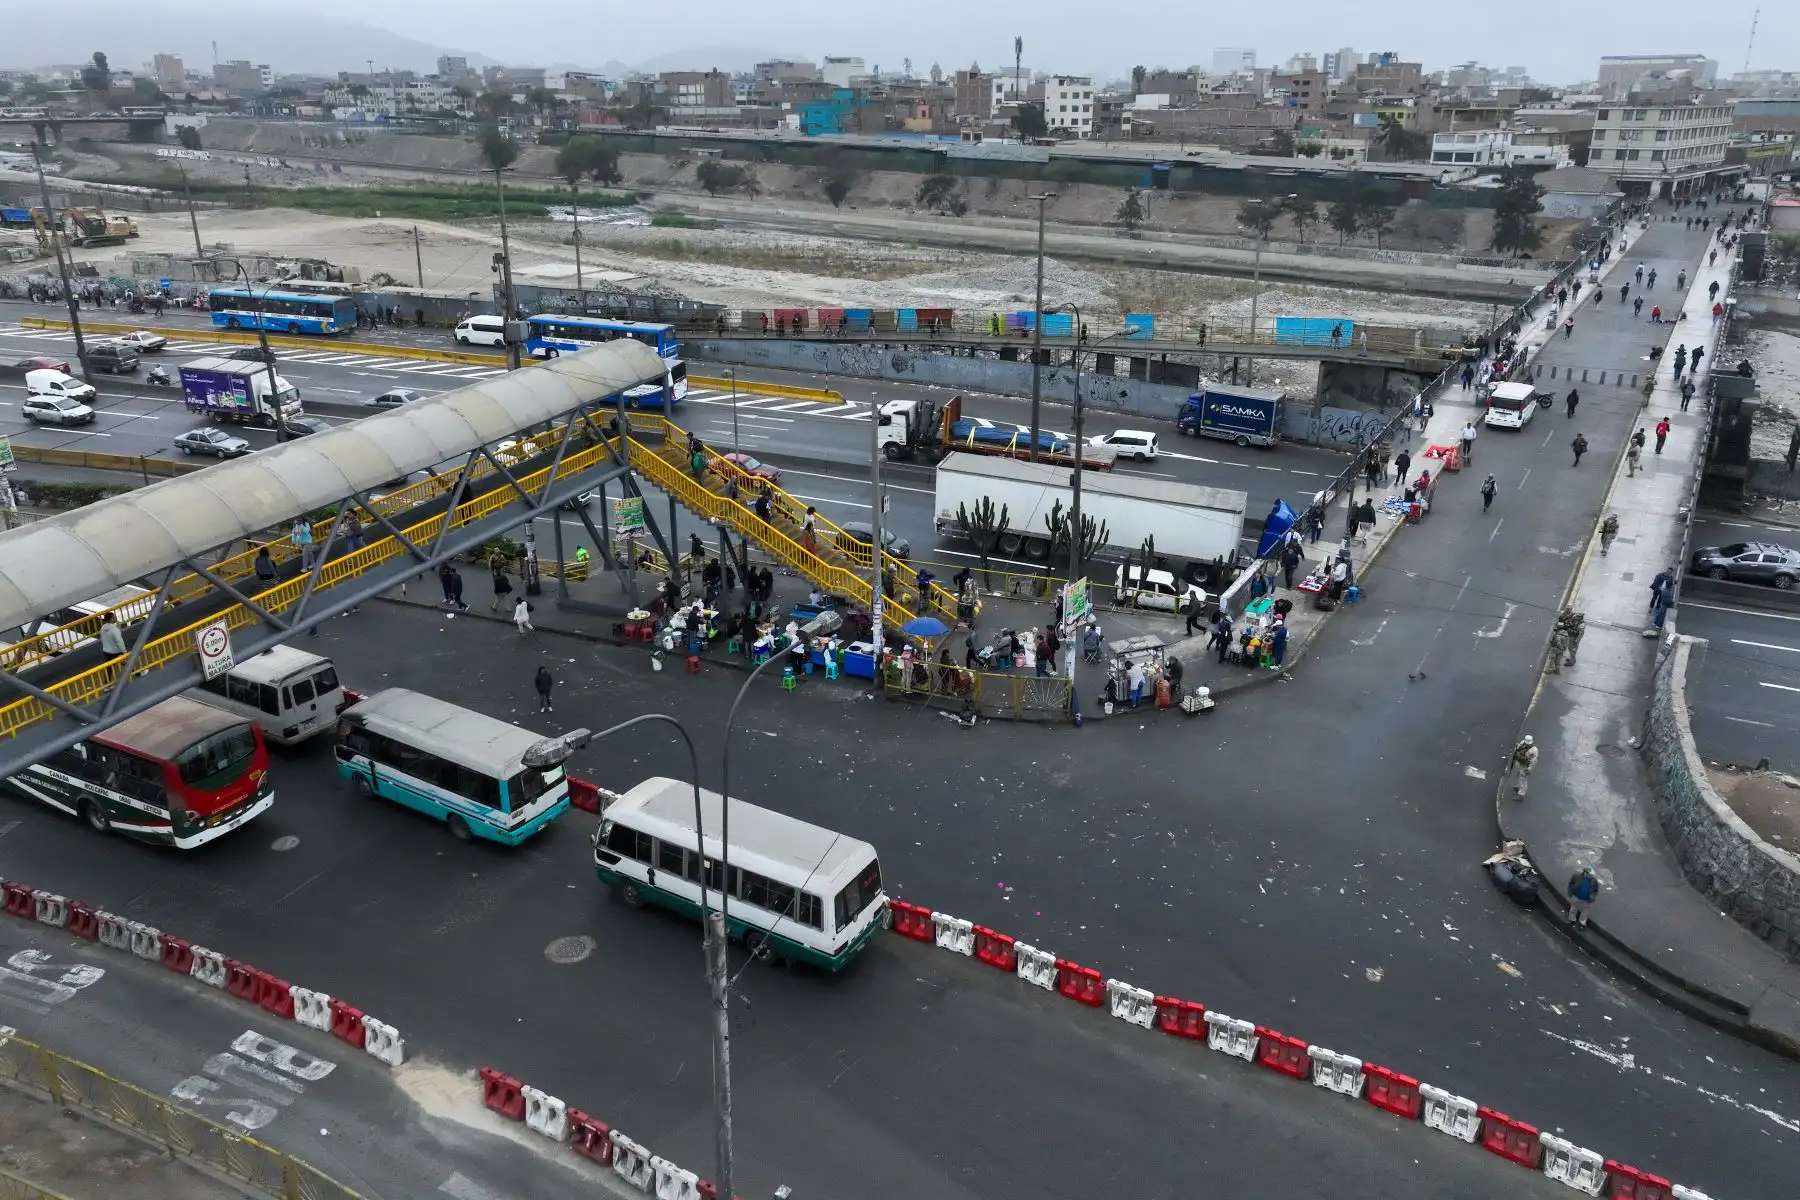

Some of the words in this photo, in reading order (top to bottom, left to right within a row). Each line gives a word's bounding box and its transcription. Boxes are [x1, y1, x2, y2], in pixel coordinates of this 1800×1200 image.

[1221, 404, 1266, 418] SAMKA
[207, 655, 231, 670] ALTURA
[49, 770, 70, 783] CANADA
[171, 1029, 337, 1130] BUS
